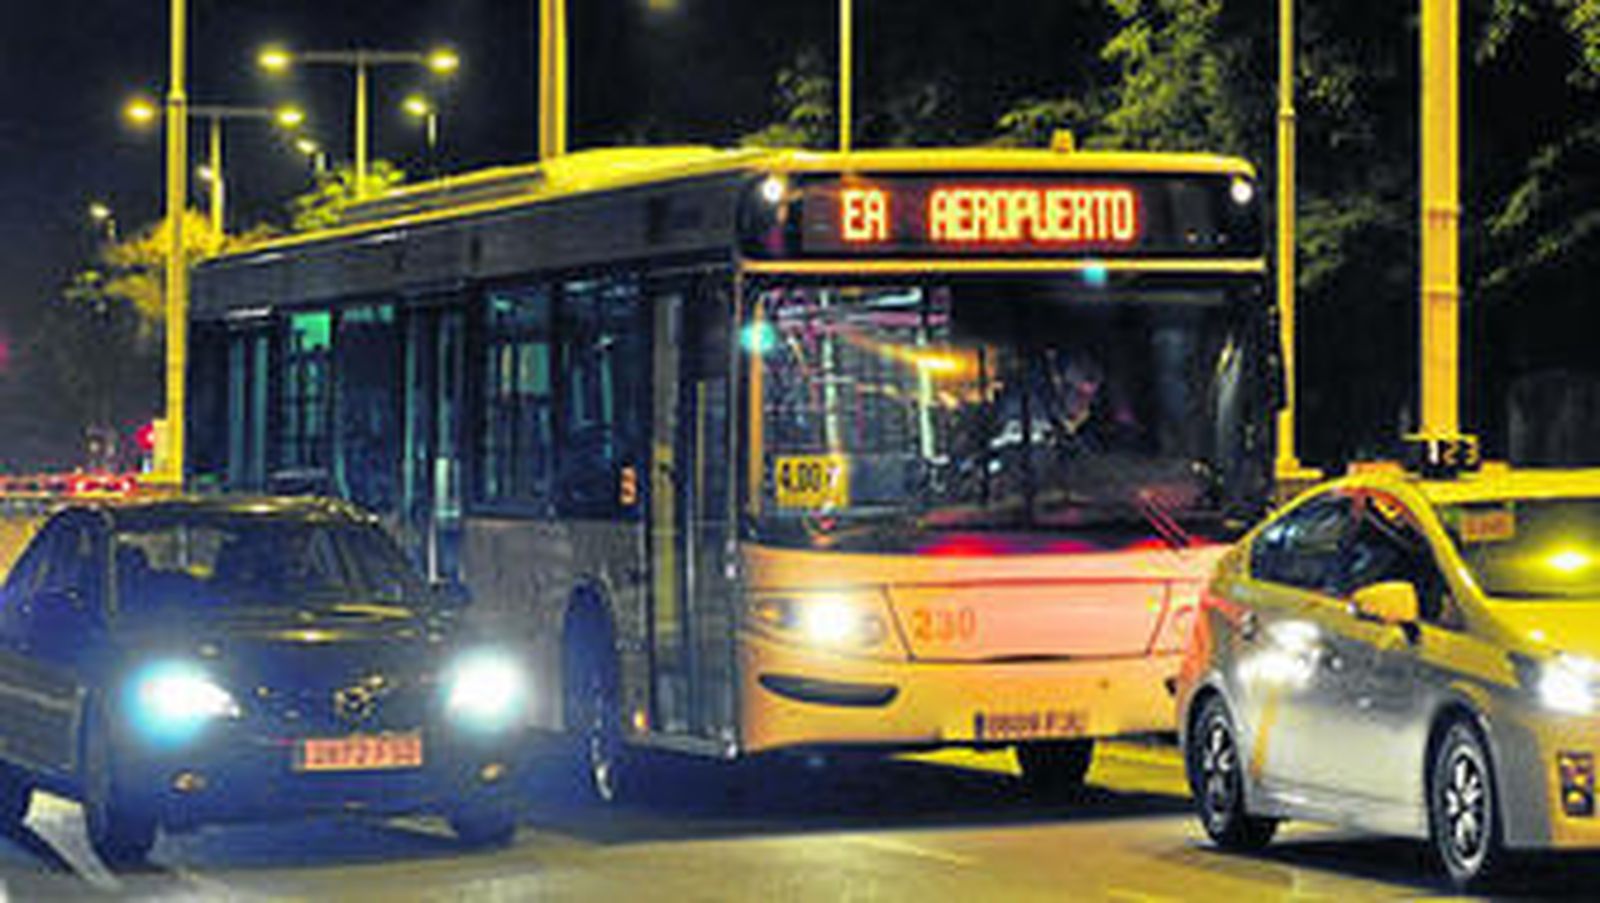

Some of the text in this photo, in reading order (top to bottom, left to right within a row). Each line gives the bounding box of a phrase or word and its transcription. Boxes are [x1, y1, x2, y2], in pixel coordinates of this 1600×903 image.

[842, 188, 1137, 240] EA AEROPUERTO
[913, 606, 977, 642] 230
